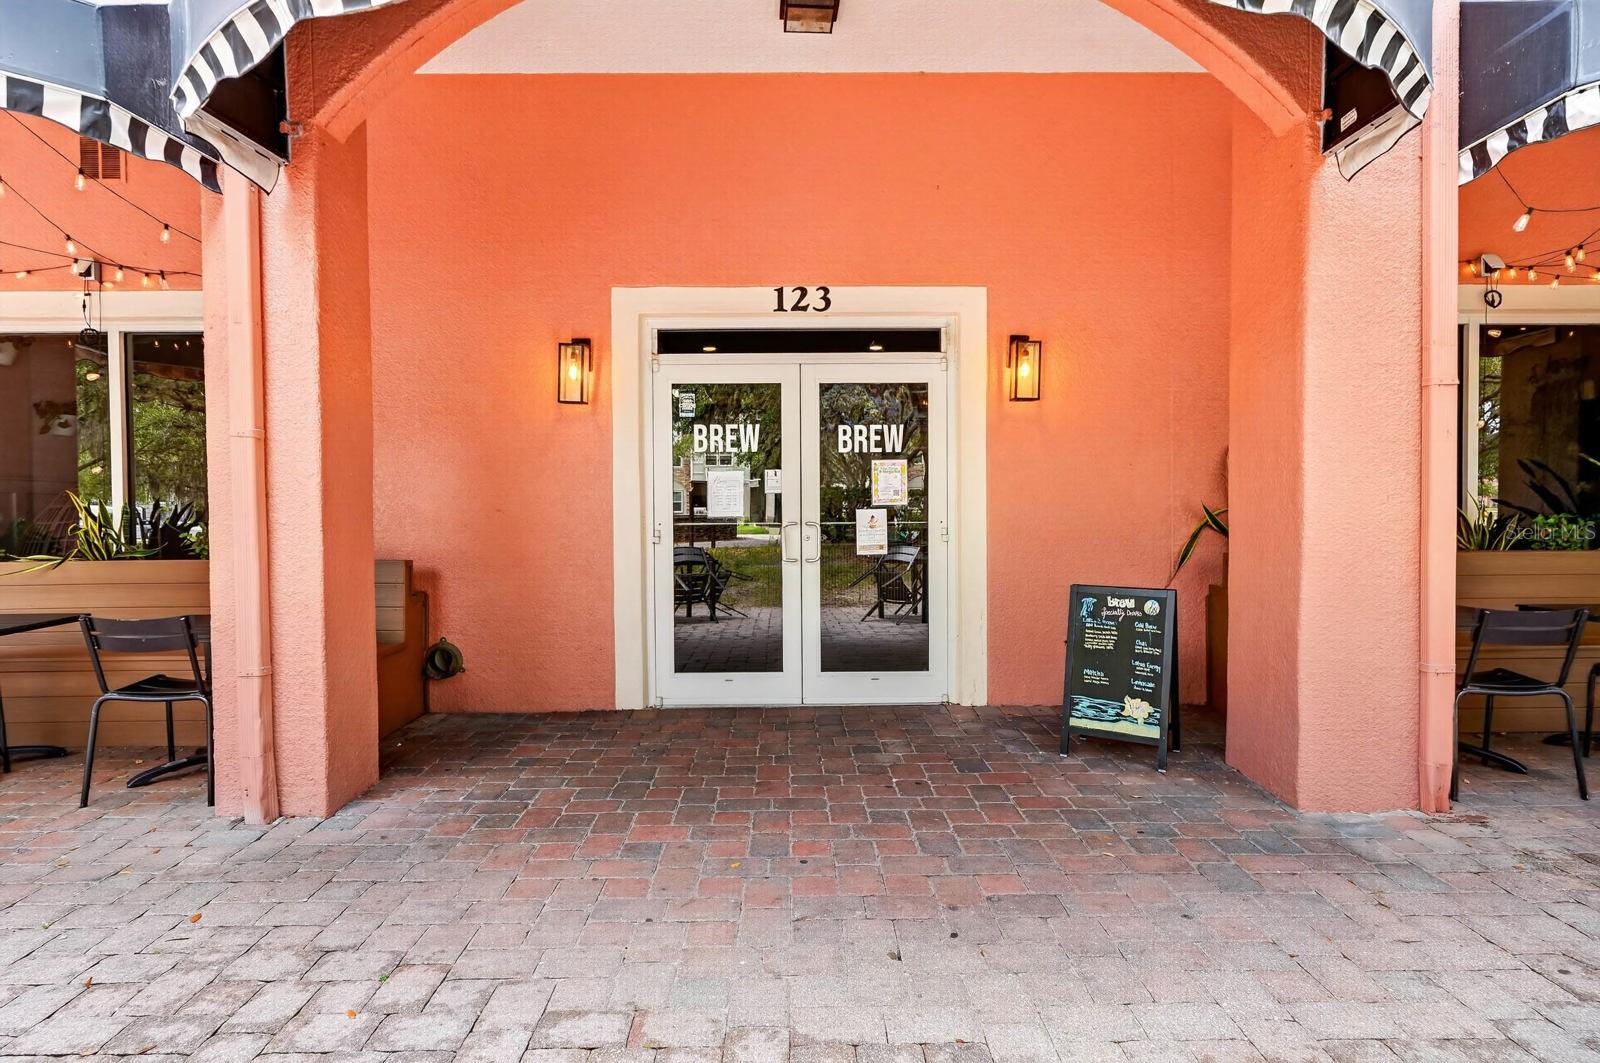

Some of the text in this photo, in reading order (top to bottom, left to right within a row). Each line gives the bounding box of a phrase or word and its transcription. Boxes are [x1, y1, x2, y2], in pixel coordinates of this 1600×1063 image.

[773, 286, 832, 313] 123
[693, 423, 760, 453] BREW
[837, 424, 904, 454] BREW
